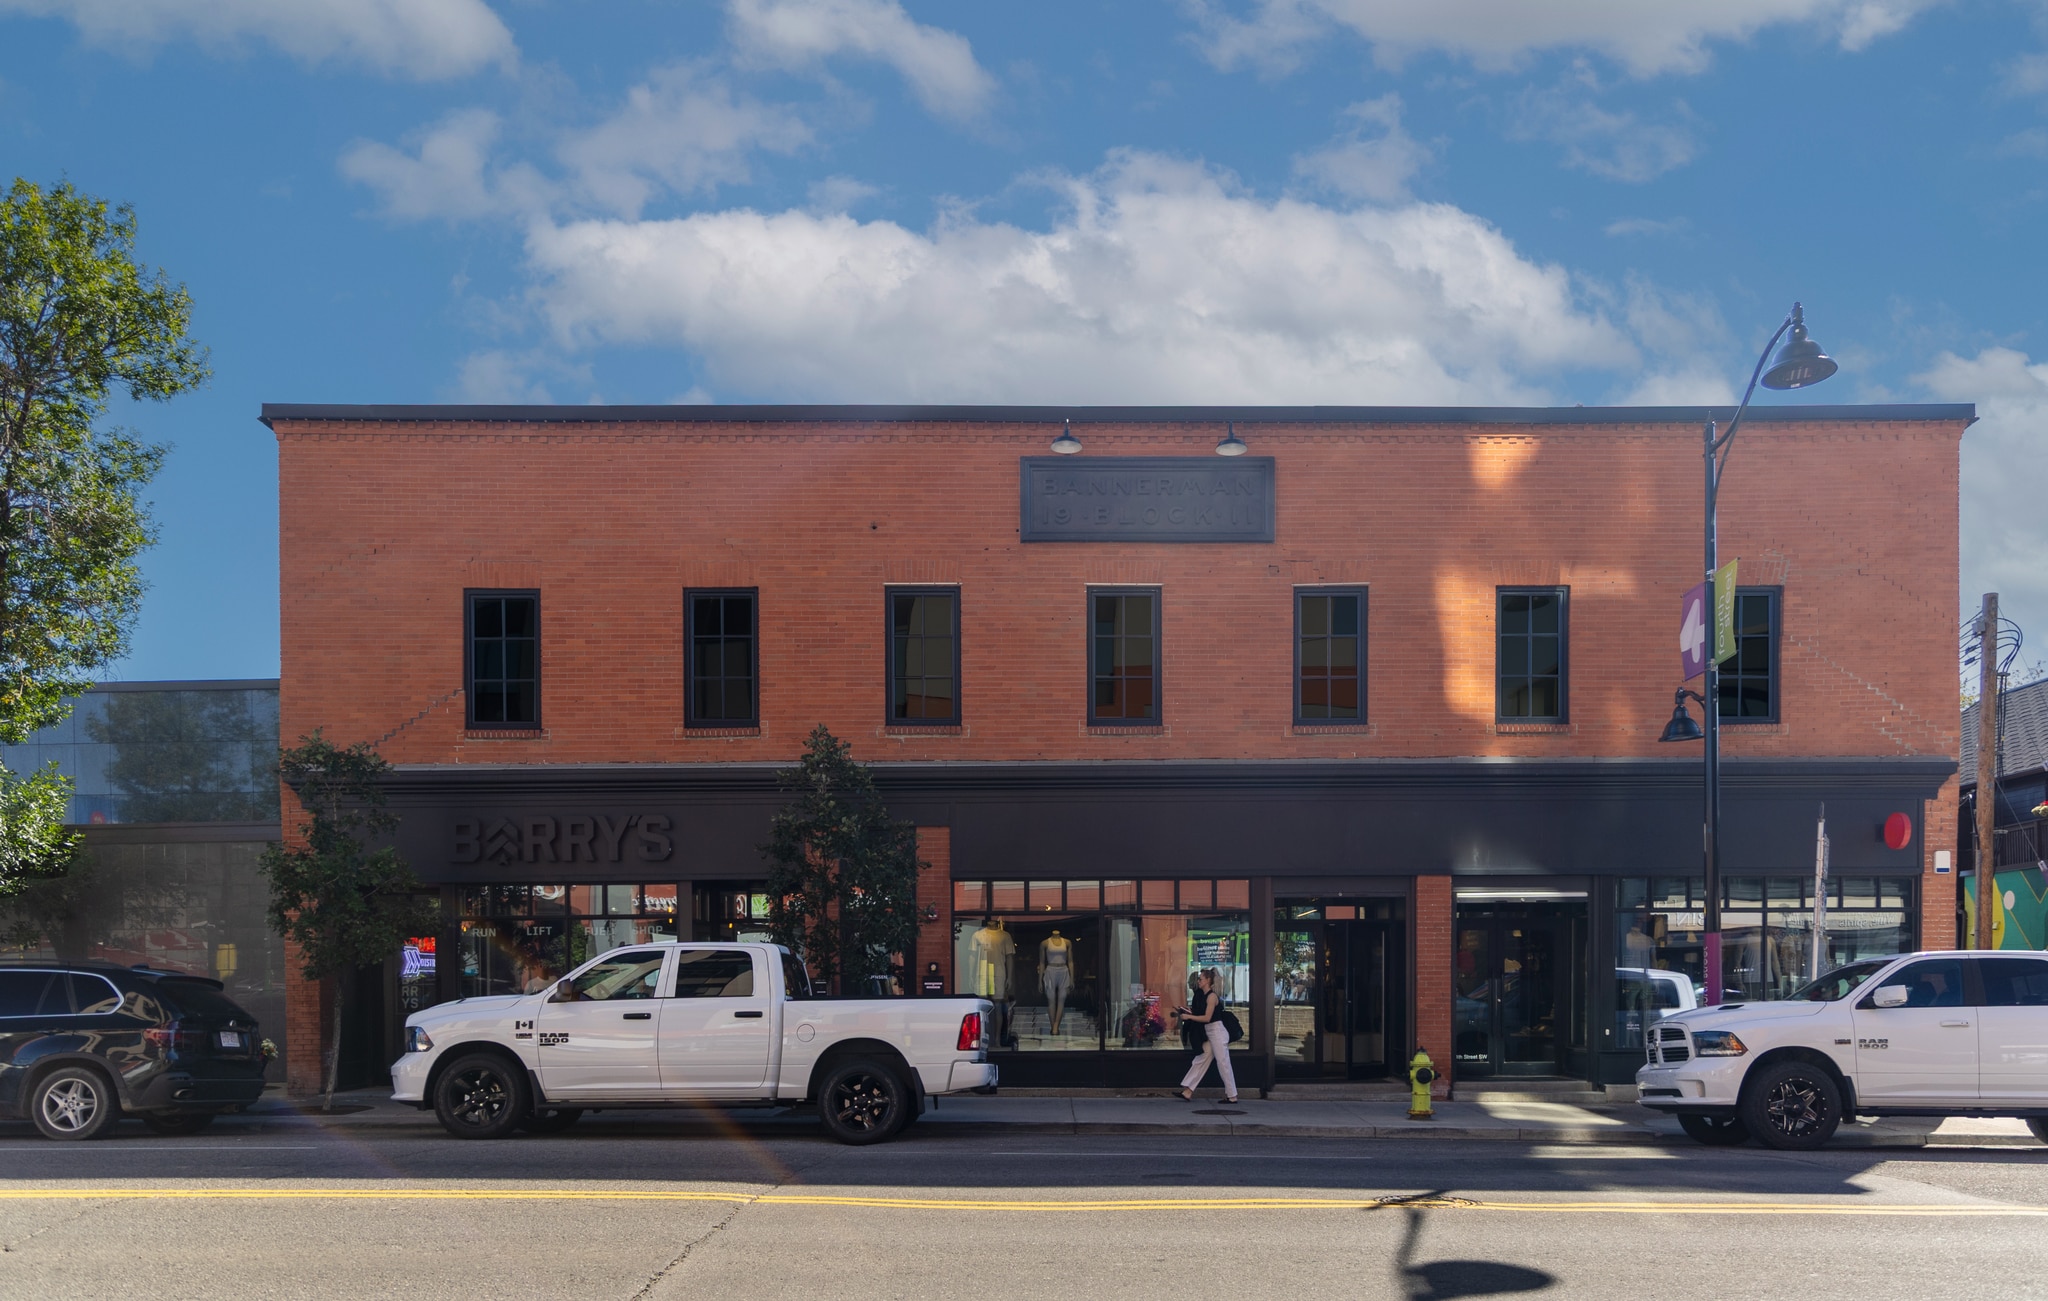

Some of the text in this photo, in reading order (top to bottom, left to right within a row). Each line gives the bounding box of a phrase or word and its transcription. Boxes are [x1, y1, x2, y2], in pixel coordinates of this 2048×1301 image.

[1042, 477, 1253, 496] BANNERMAN
[1094, 505, 1213, 526] BLOCK
[1725, 568, 1733, 628] street
[1718, 595, 1726, 656] fourth
[472, 927, 497, 937] RUN
[526, 926, 553, 936] LIFT
[632, 925, 663, 935] SHOP
